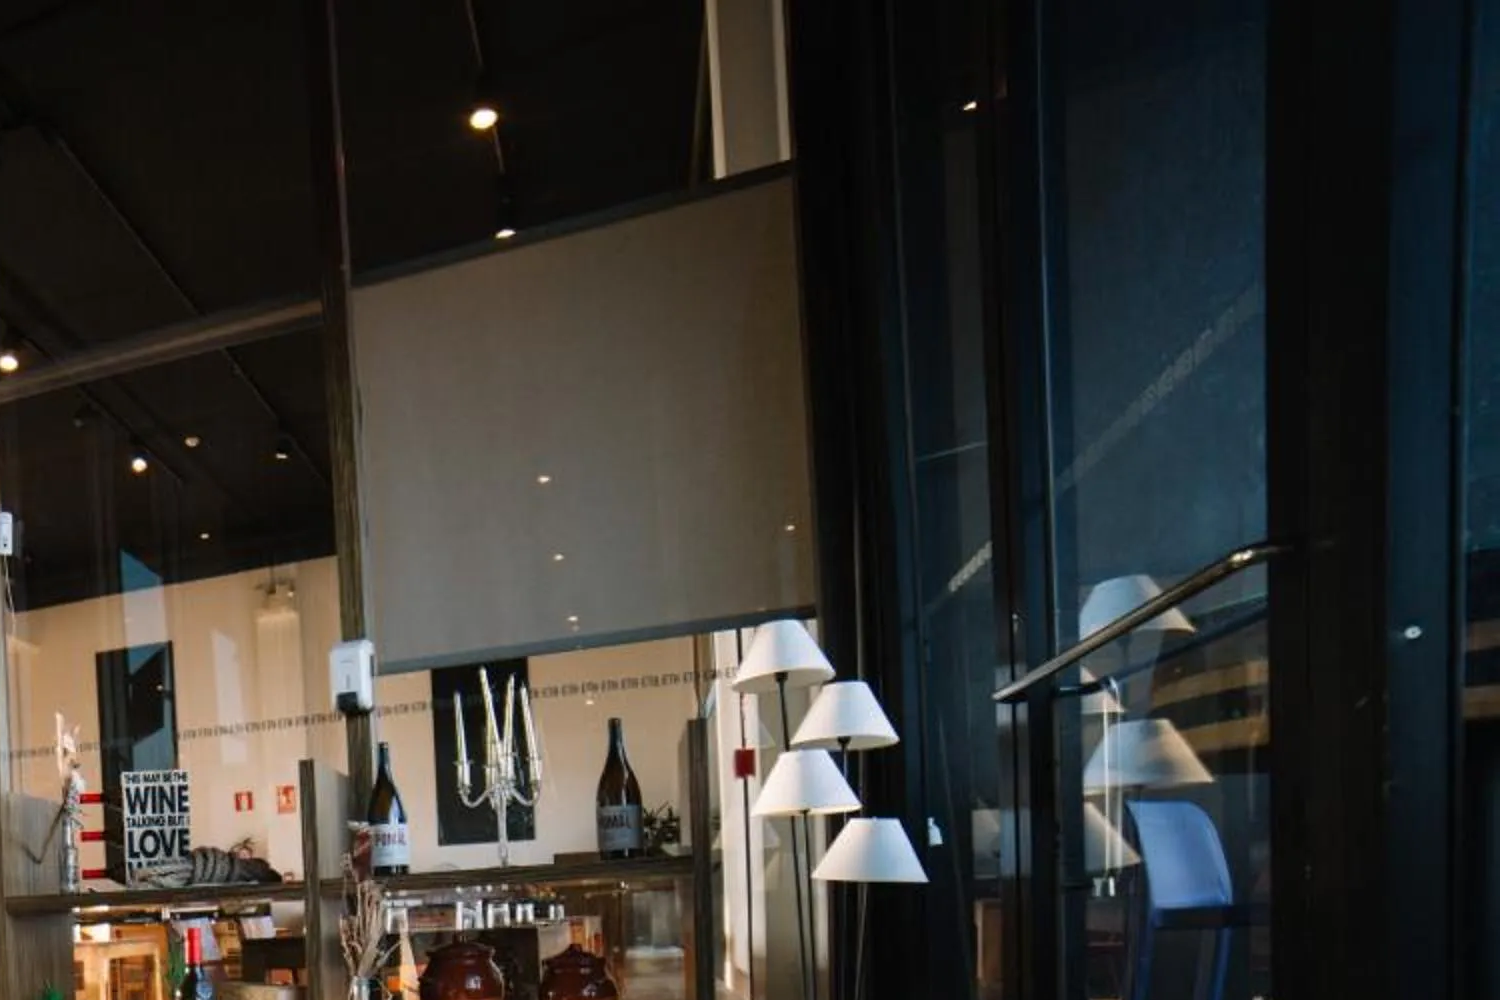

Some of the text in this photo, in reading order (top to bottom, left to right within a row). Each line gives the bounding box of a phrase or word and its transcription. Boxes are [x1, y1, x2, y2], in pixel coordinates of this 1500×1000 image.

[143, 773, 160, 782] MAY
[174, 771, 187, 782] THE
[125, 785, 189, 814] WINE
[168, 815, 184, 826] BUT
[127, 829, 190, 858] LOVE
